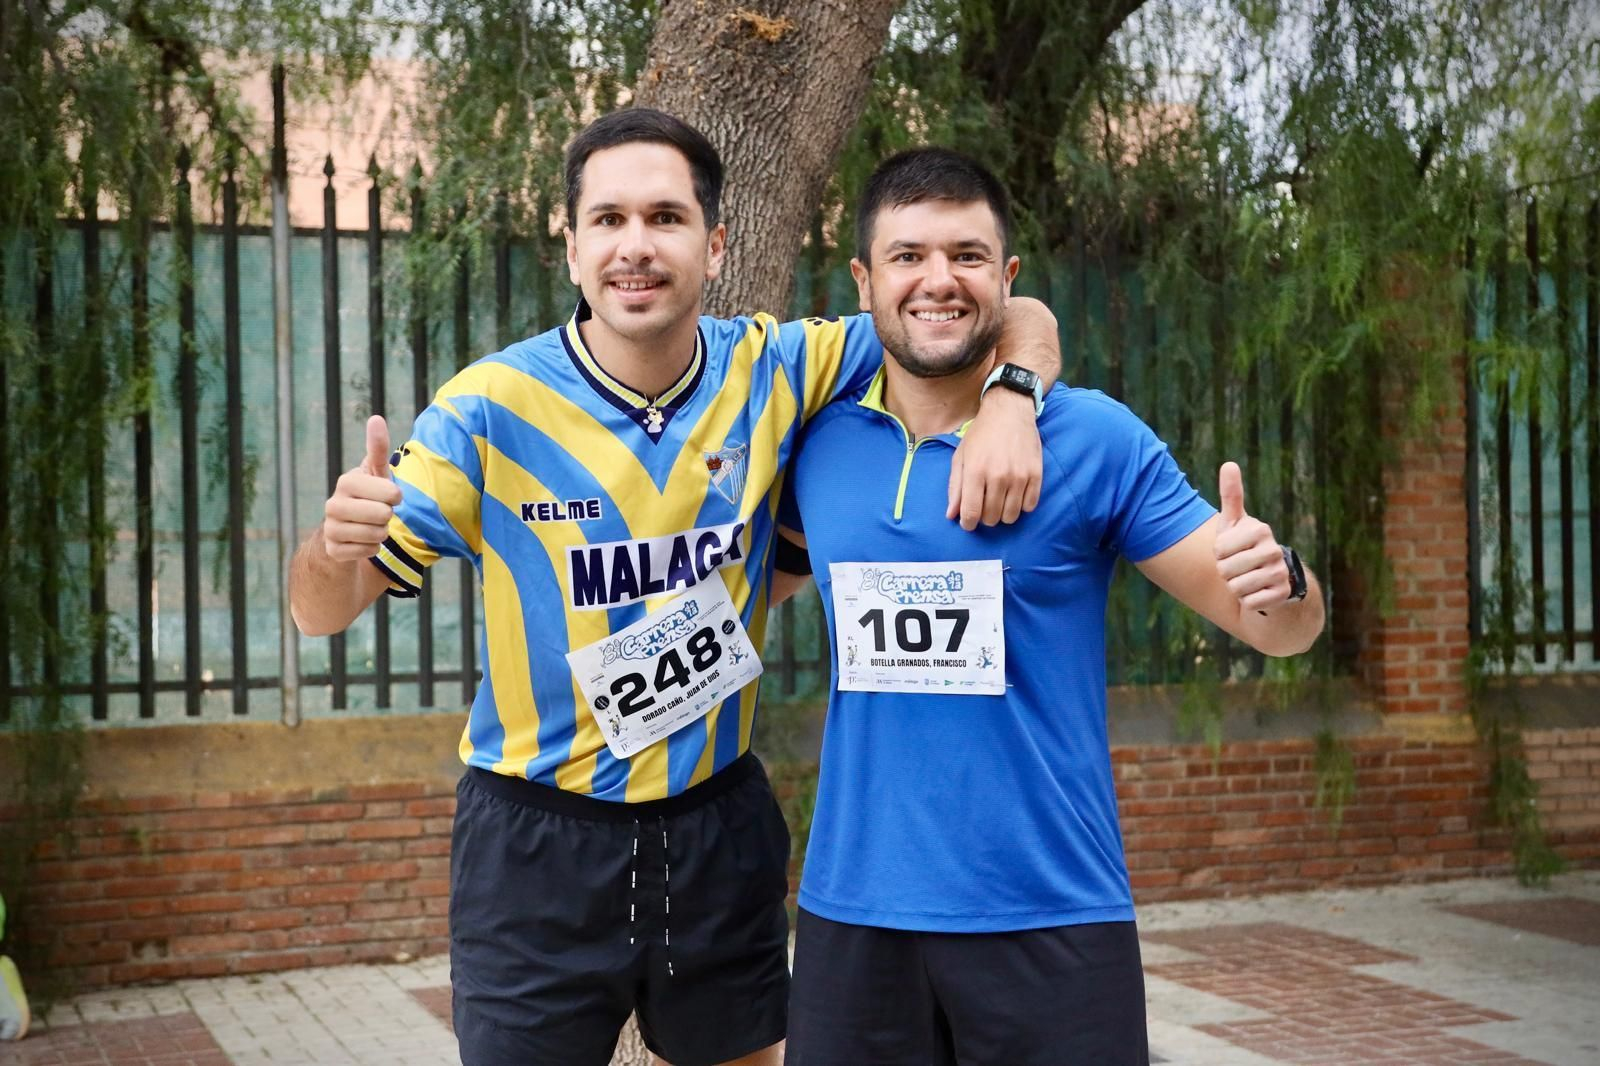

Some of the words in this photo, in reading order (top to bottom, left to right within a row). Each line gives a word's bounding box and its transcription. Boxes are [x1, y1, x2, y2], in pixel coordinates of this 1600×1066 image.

[521, 500, 600, 521] KELME
[623, 610, 688, 656] Carrera
[858, 608, 970, 653] 107
[610, 626, 722, 718] 248
[870, 658, 896, 667] BOTELLA
[897, 658, 932, 668] GRANADOS,
[933, 659, 967, 668] FRANCISCO
[641, 705, 667, 723] DORADO
[686, 684, 701, 700] JUAN
[700, 679, 708, 689] DE
[707, 669, 720, 686] DIOS
